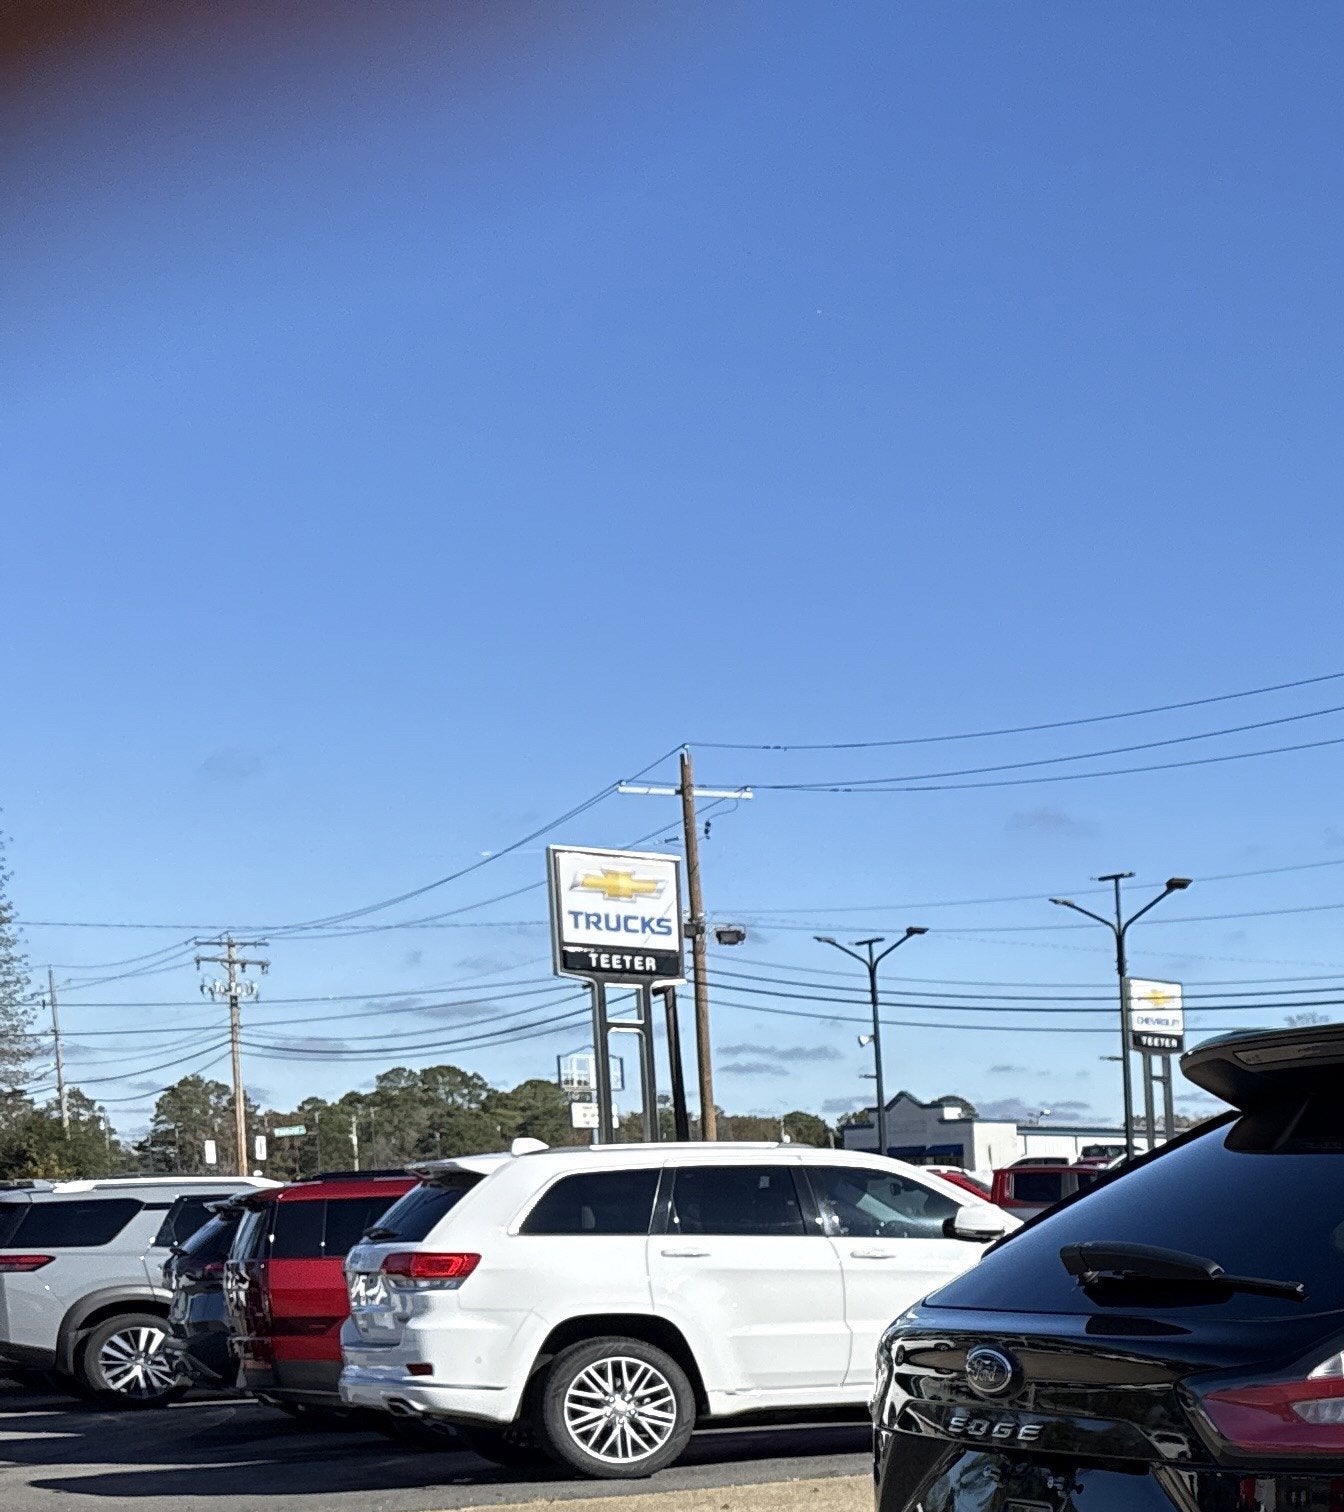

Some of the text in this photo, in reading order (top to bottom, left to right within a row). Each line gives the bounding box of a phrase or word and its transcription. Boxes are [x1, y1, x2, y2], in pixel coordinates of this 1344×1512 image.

[567, 910, 673, 936] TRUCKS
[589, 953, 657, 971] TEETER
[1141, 1035, 1178, 1048] TEETER
[948, 1416, 1045, 1441] EDGE
